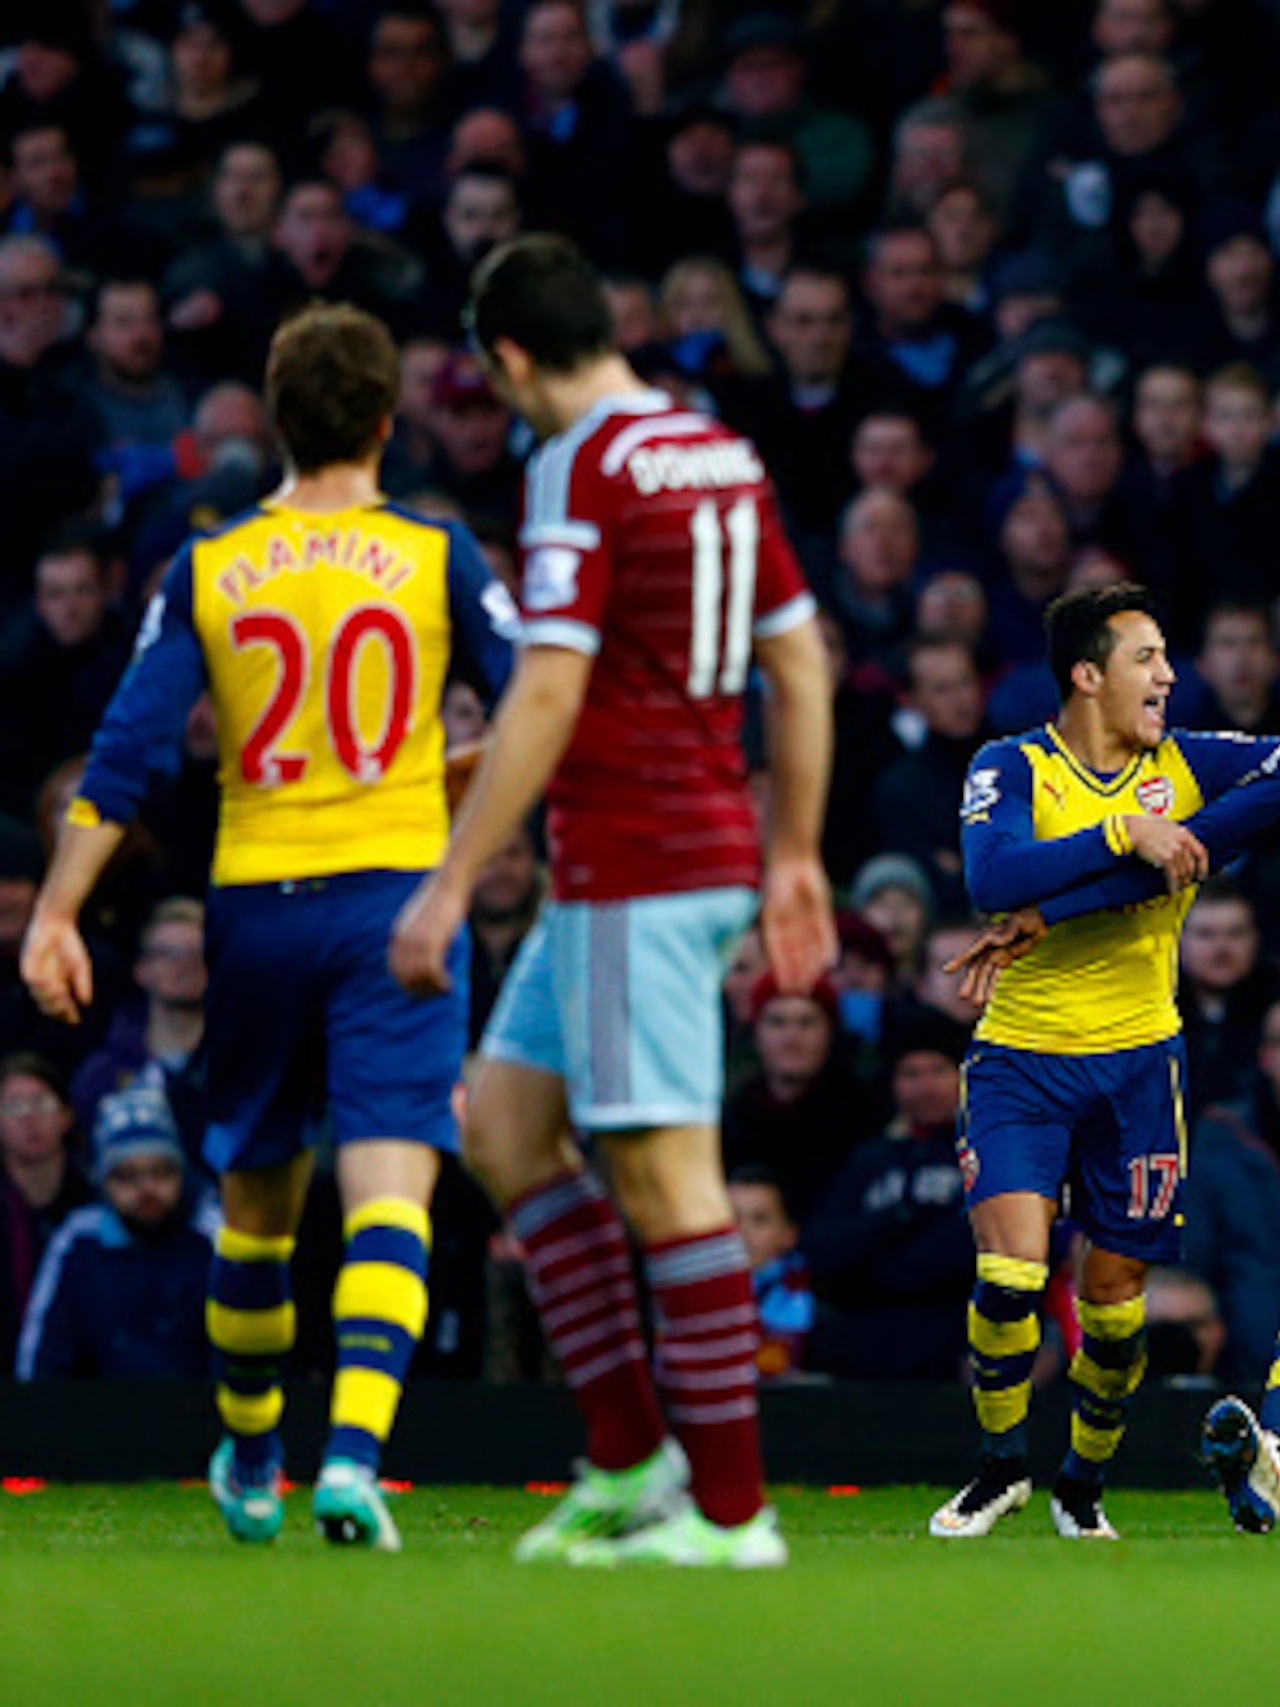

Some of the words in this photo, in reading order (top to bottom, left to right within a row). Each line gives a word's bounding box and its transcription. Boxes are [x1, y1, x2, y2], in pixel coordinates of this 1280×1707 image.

[217, 530, 413, 604] FLAMINI
[688, 497, 758, 698] 11
[229, 600, 418, 787] 20
[1127, 1153, 1179, 1218] 17
